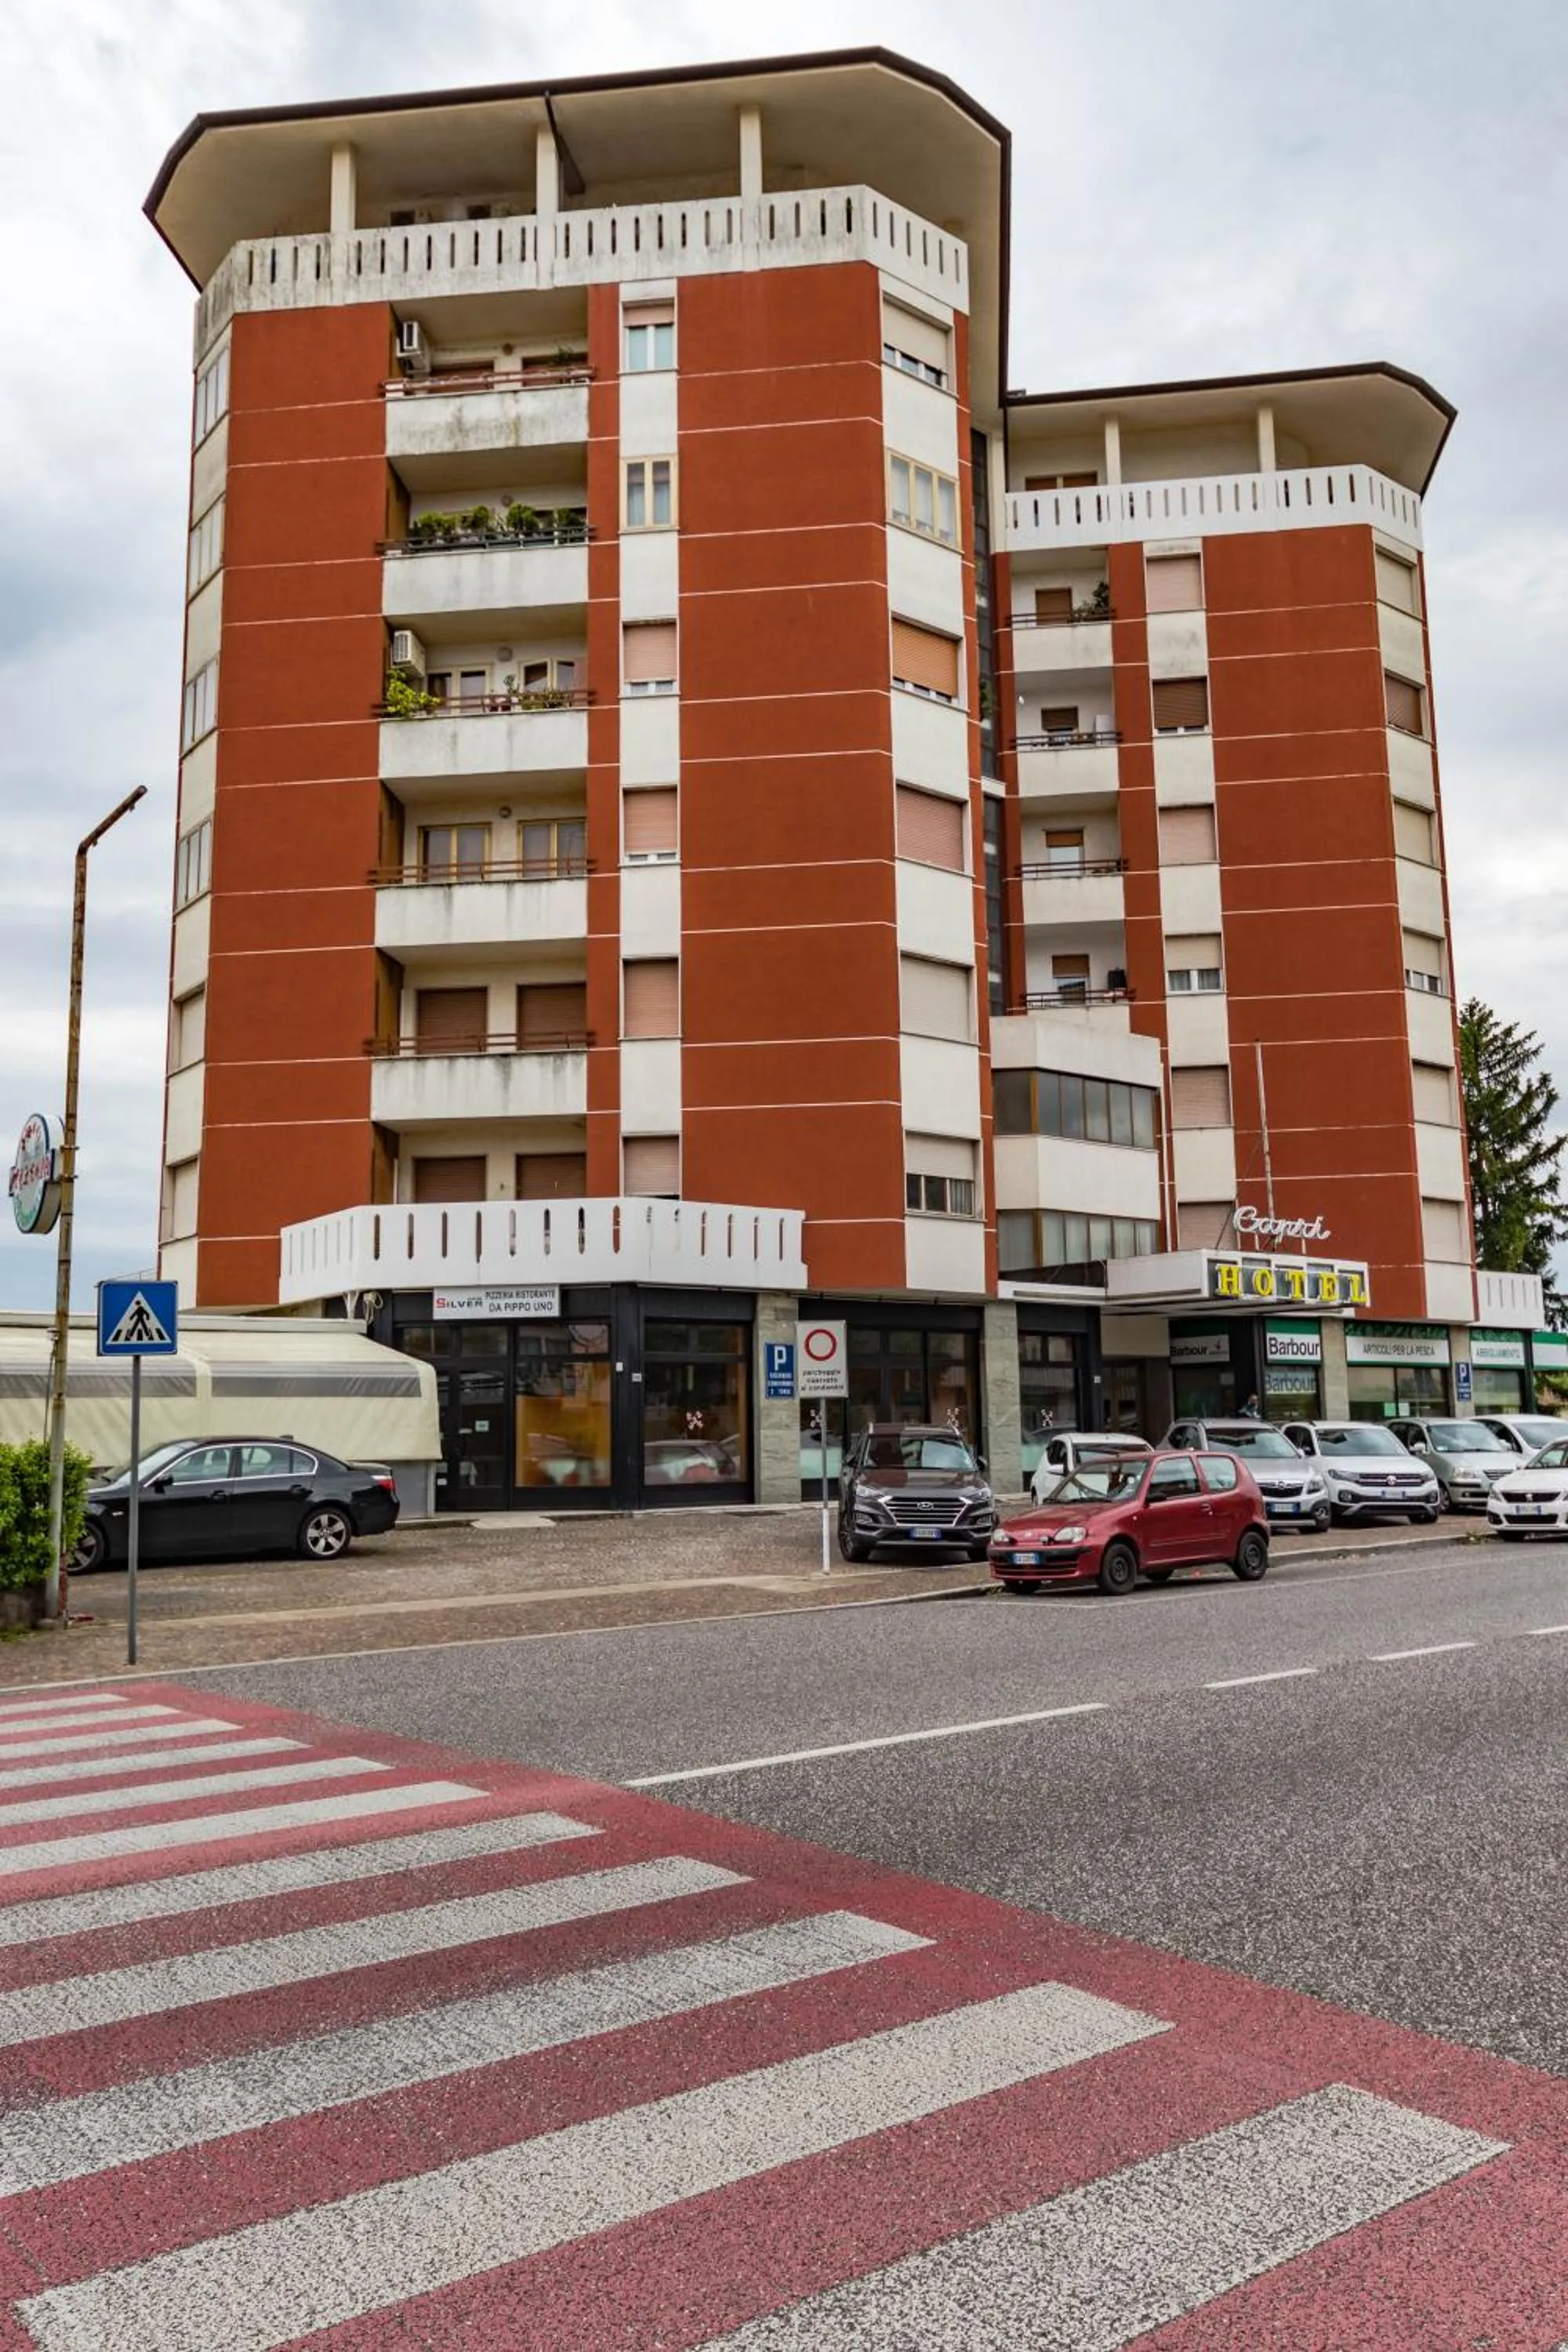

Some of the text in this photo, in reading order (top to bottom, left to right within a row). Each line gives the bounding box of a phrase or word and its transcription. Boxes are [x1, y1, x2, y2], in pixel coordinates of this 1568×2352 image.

[1217, 1265, 1367, 1304] HOTEL
[515, 1290, 556, 1299] RISTORANTE
[436, 1298, 483, 1308] SILVER
[488, 1301, 553, 1312] DA PIPPO UNO
[1170, 1345, 1207, 1357] Barbour
[1269, 1337, 1319, 1356] Barbour
[1392, 1344, 1406, 1356] PER
[1406, 1345, 1415, 1356] LA
[1416, 1344, 1436, 1356] PESCA
[775, 1345, 786, 1370] P
[1460, 1363, 1467, 1382] P
[1265, 1373, 1317, 1392] Barbour
